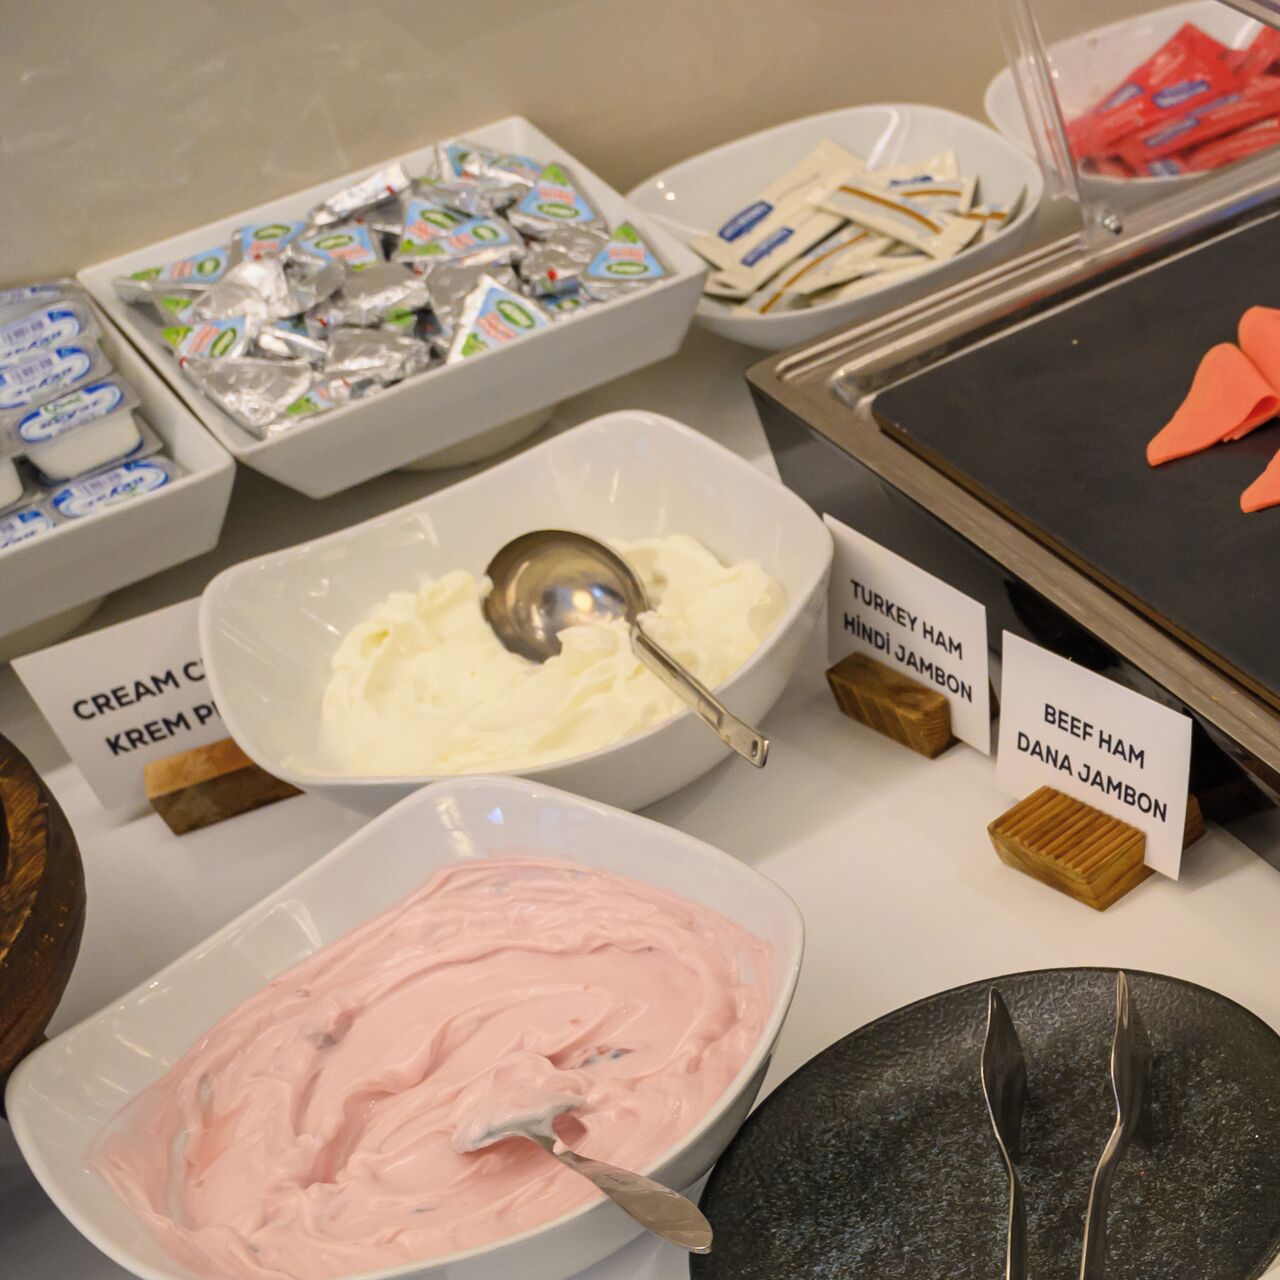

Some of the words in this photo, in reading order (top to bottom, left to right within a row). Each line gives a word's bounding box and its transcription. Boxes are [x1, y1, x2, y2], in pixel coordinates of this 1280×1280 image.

[850, 578, 917, 631] TURKEY
[923, 622, 962, 660] HAM
[843, 612, 890, 654] HİNDİ
[894, 645, 971, 702] JAMBON
[73, 670, 180, 720] CREAM
[106, 713, 191, 755] KREM
[1045, 704, 1093, 740] BEEF
[1099, 730, 1144, 769] HAM
[1018, 732, 1072, 775] DANA
[1078, 764, 1167, 822] JAMBON
